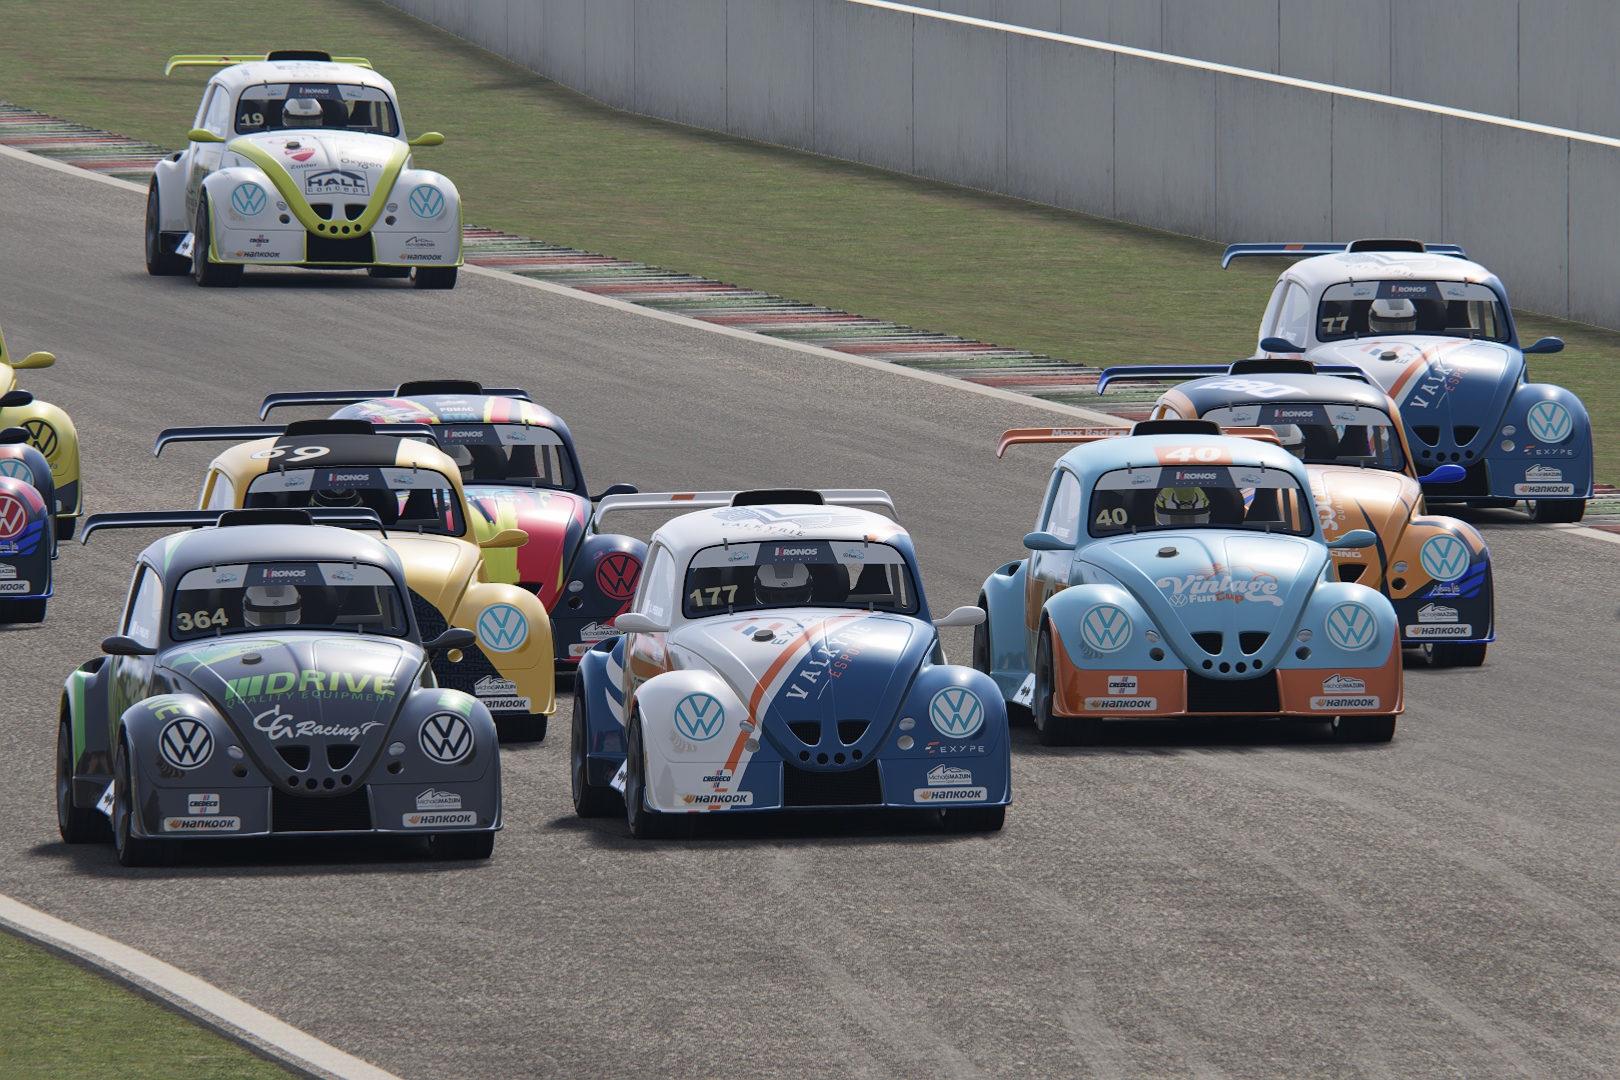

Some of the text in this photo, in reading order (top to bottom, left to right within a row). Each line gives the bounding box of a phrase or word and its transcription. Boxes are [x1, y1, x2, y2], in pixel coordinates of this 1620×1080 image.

[240, 112, 264, 126] 19
[341, 158, 383, 170] Oxygen
[308, 178, 365, 188] HALL
[308, 186, 366, 194] concept
[1322, 316, 1349, 333] 77
[1274, 407, 1314, 418] KRONOS
[444, 428, 483, 438] KRONOS
[1051, 428, 1084, 437] Maxx
[250, 445, 331, 462] 69
[1165, 448, 1221, 462] 40
[328, 472, 370, 482] KRONOS
[1176, 471, 1217, 481] KRONOS
[1096, 508, 1127, 526] 40
[721, 522, 806, 537] VALKYRIE
[774, 545, 818, 557] KRONOS
[262, 567, 306, 578] KRONOS
[690, 585, 738, 607] 177
[1156, 575, 1283, 607] Vintage
[177, 608, 229, 631] 364
[265, 670, 398, 696] DRIVE
[226, 689, 396, 709] QUALITY EQUIPMENT
[295, 720, 376, 741] Racing
[940, 745, 985, 753] EXYPE
